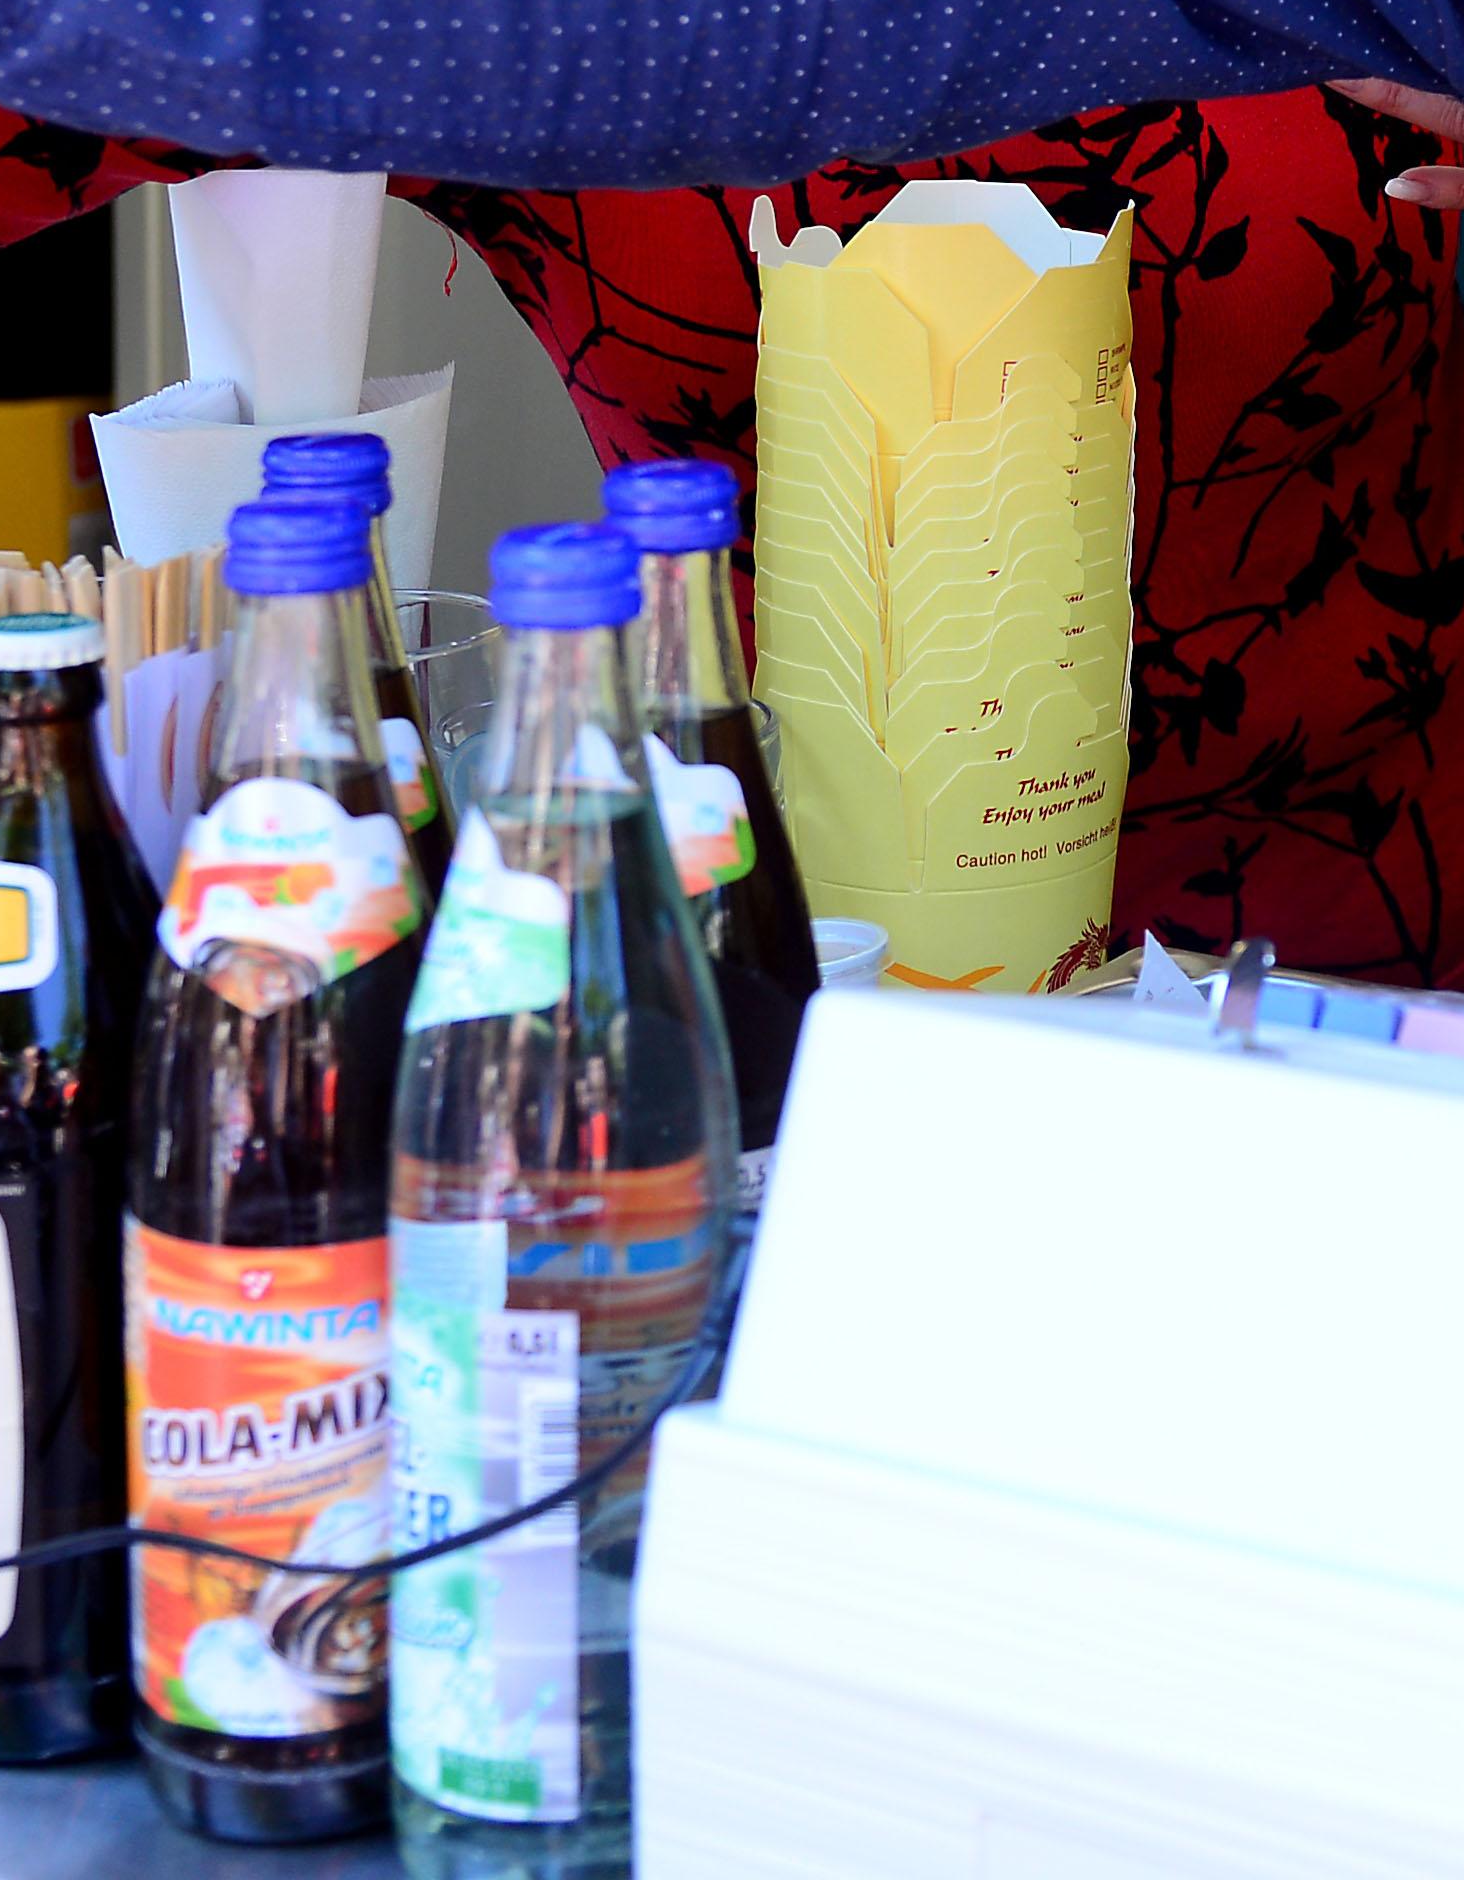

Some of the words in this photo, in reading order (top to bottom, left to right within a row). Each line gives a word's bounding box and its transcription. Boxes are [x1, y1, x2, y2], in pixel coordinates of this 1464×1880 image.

[1018, 771, 1069, 796] Thank
[1073, 768, 1097, 789] you
[983, 806, 1035, 826] Enjoy
[1038, 798, 1075, 820] your
[1078, 781, 1106, 808] meal
[956, 852, 1016, 869] Caution
[1021, 845, 1047, 862] hot!
[1056, 829, 1098, 855] Vorsicht
